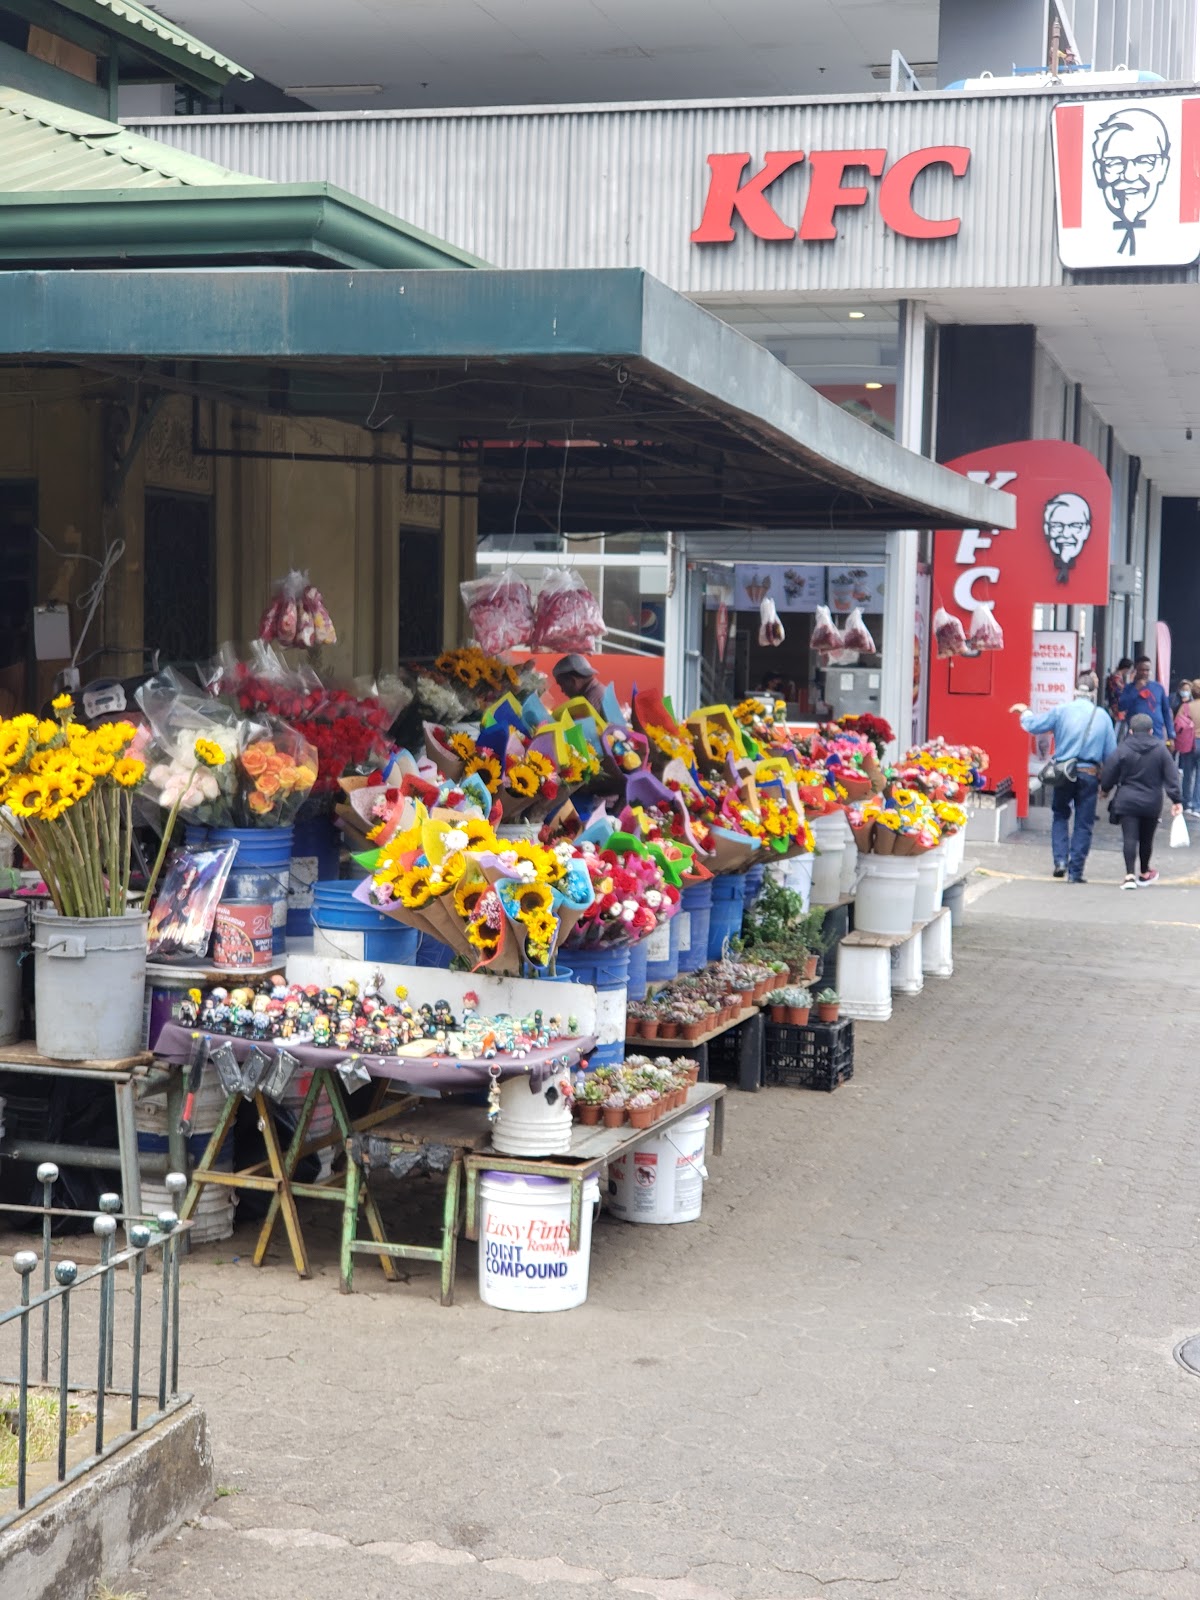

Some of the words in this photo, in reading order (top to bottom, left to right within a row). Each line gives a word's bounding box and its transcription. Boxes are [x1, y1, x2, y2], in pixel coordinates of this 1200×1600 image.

[690, 146, 971, 242] KFC
[485, 1213, 526, 1244] Easy
[526, 1219, 570, 1240] Finis
[485, 1239, 523, 1263] JOINT
[527, 1239, 560, 1255] Ready
[485, 1257, 569, 1280] COMPOUND
